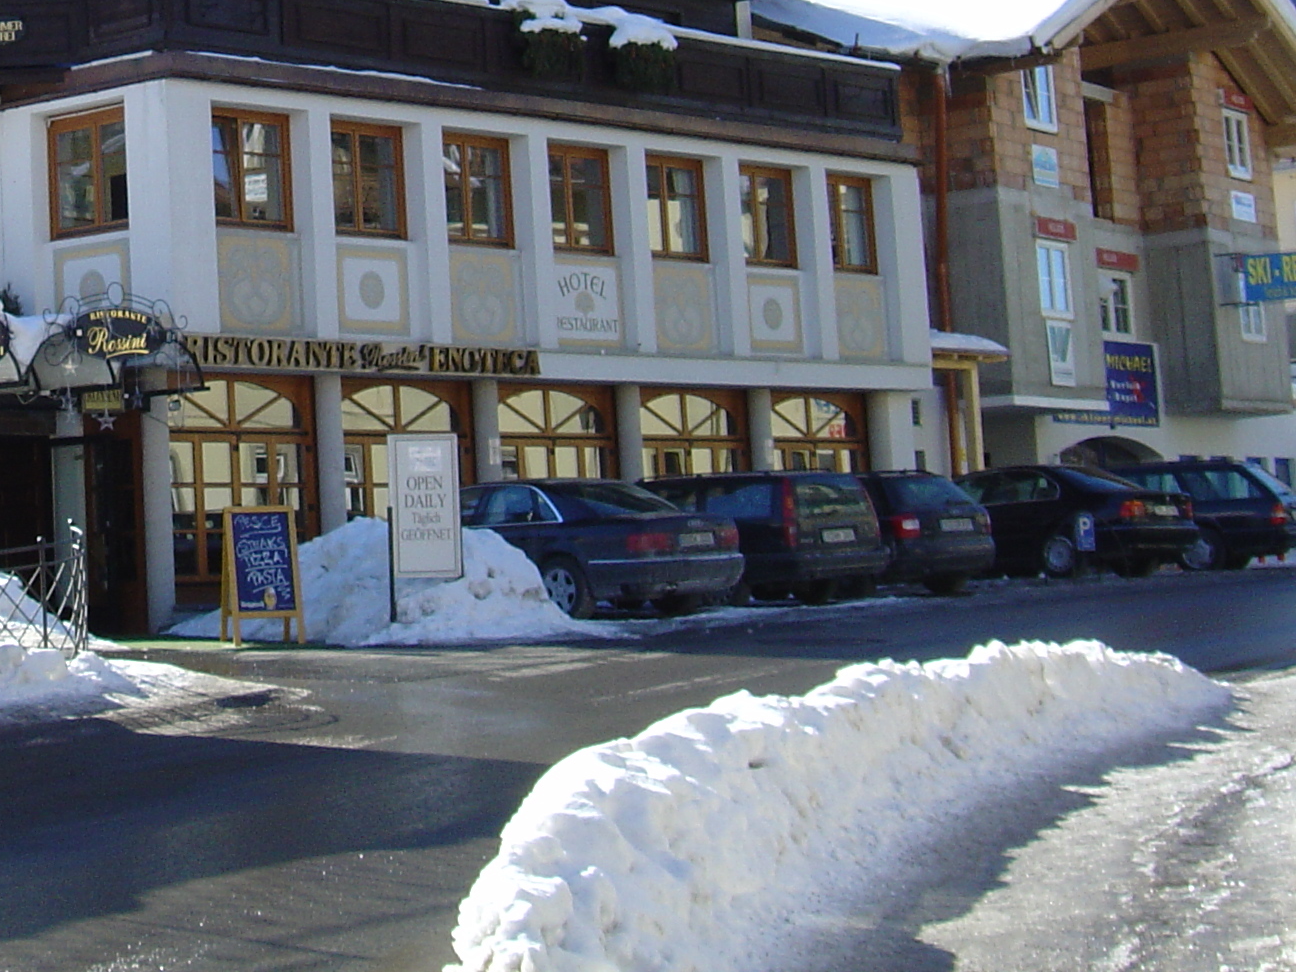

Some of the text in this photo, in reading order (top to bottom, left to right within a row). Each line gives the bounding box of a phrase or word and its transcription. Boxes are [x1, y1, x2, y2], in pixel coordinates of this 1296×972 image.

[1247, 257, 1272, 285] SKI
[557, 271, 607, 300] HOTEL
[556, 316, 619, 333] RESTAURANT
[87, 326, 147, 355] Rossini
[186, 335, 358, 370] RISTORANTE
[428, 345, 541, 375] ENOTECA
[1105, 353, 1153, 373] MICHAEL
[406, 476, 444, 492] OPEN
[404, 493, 448, 509] DAILY
[400, 526, 453, 542] GEÖFFNET
[1079, 517, 1091, 536] P
[247, 568, 289, 587] PASTA
